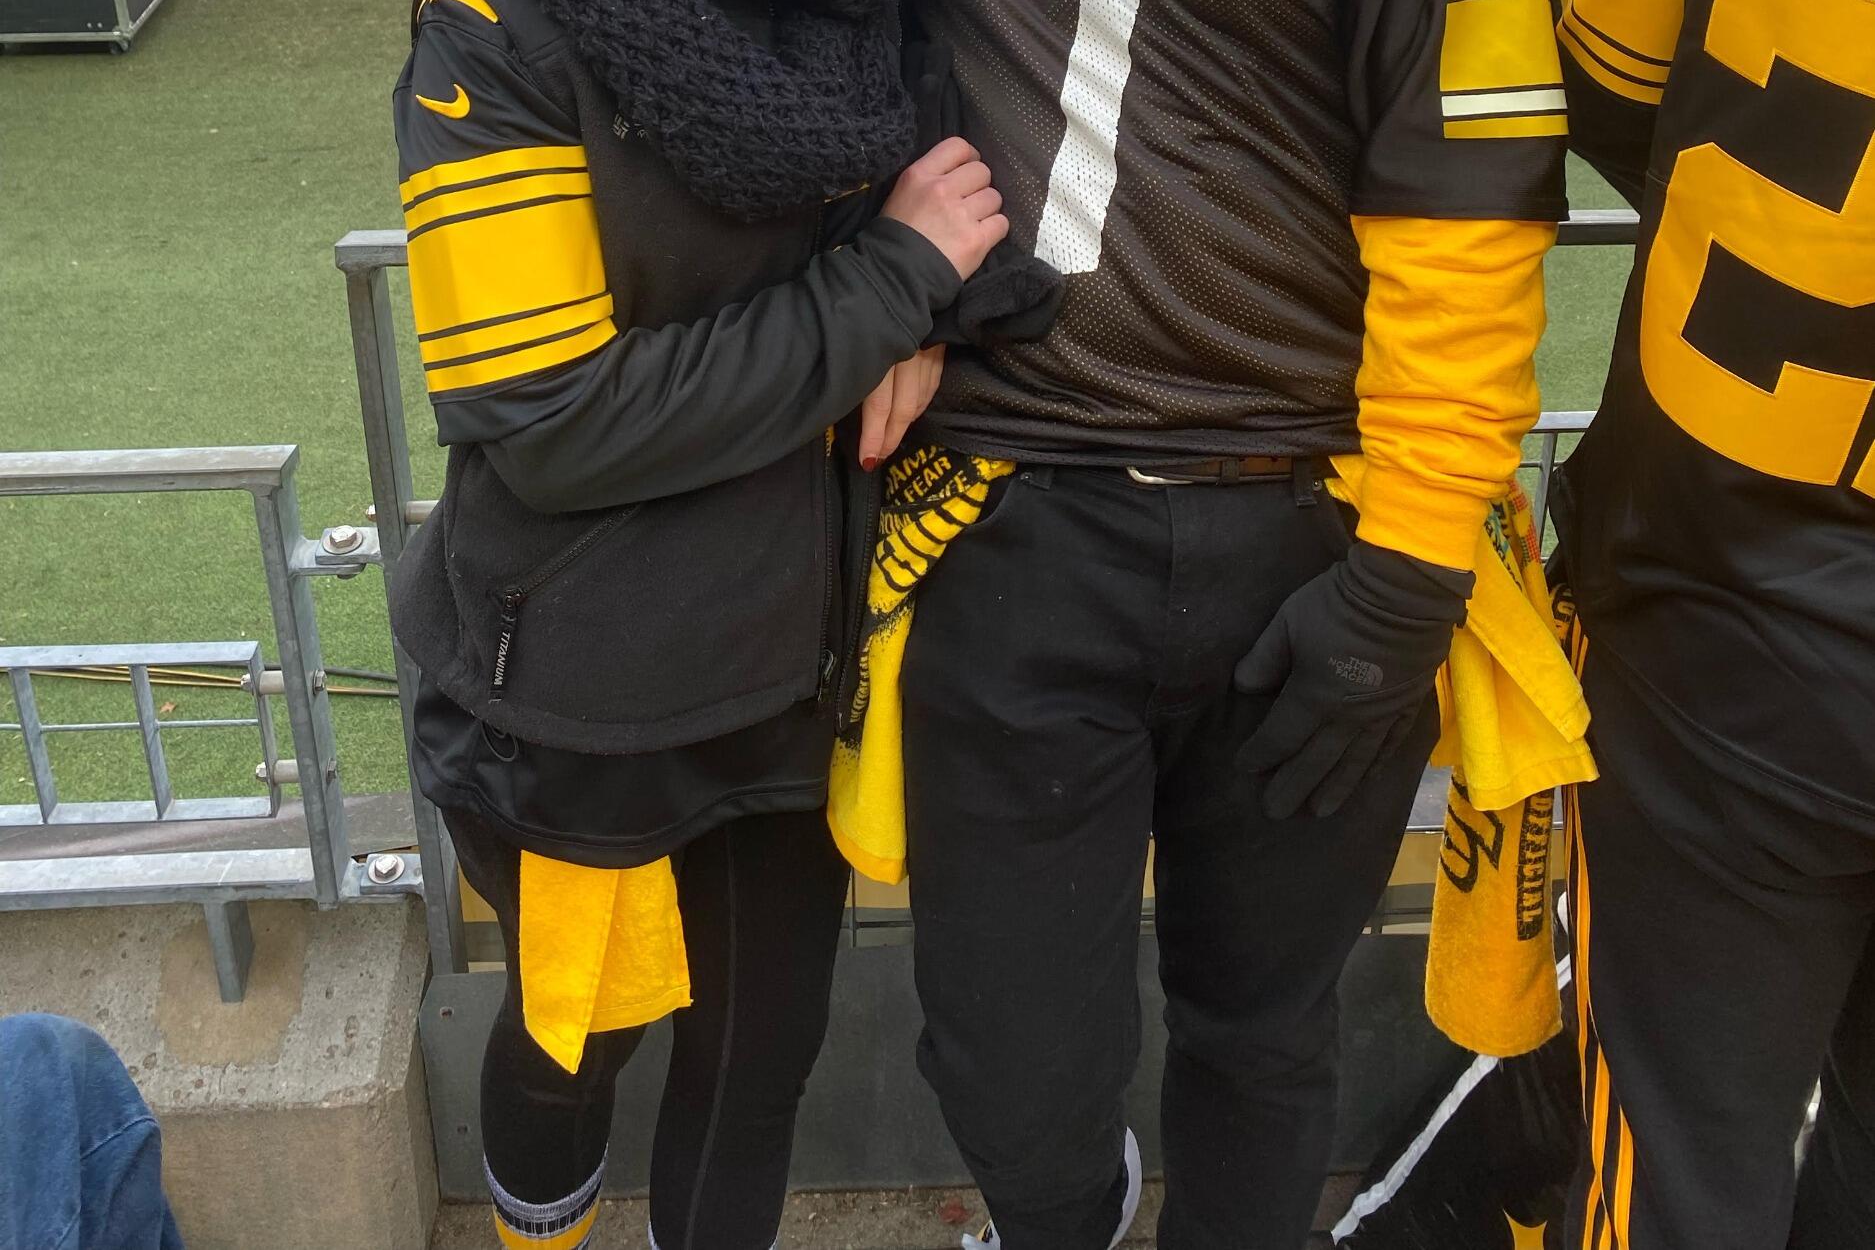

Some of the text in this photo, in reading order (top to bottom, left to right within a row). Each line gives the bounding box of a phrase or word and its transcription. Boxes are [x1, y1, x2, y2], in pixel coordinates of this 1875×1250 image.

[903, 456, 952, 503] FEAR
[493, 631, 511, 686] TITANIUM
[1327, 656, 1368, 677] NORTH
[1349, 656, 1370, 670] THE
[1335, 667, 1368, 685] FACE
[1522, 794, 1554, 923] OFFICIAL
